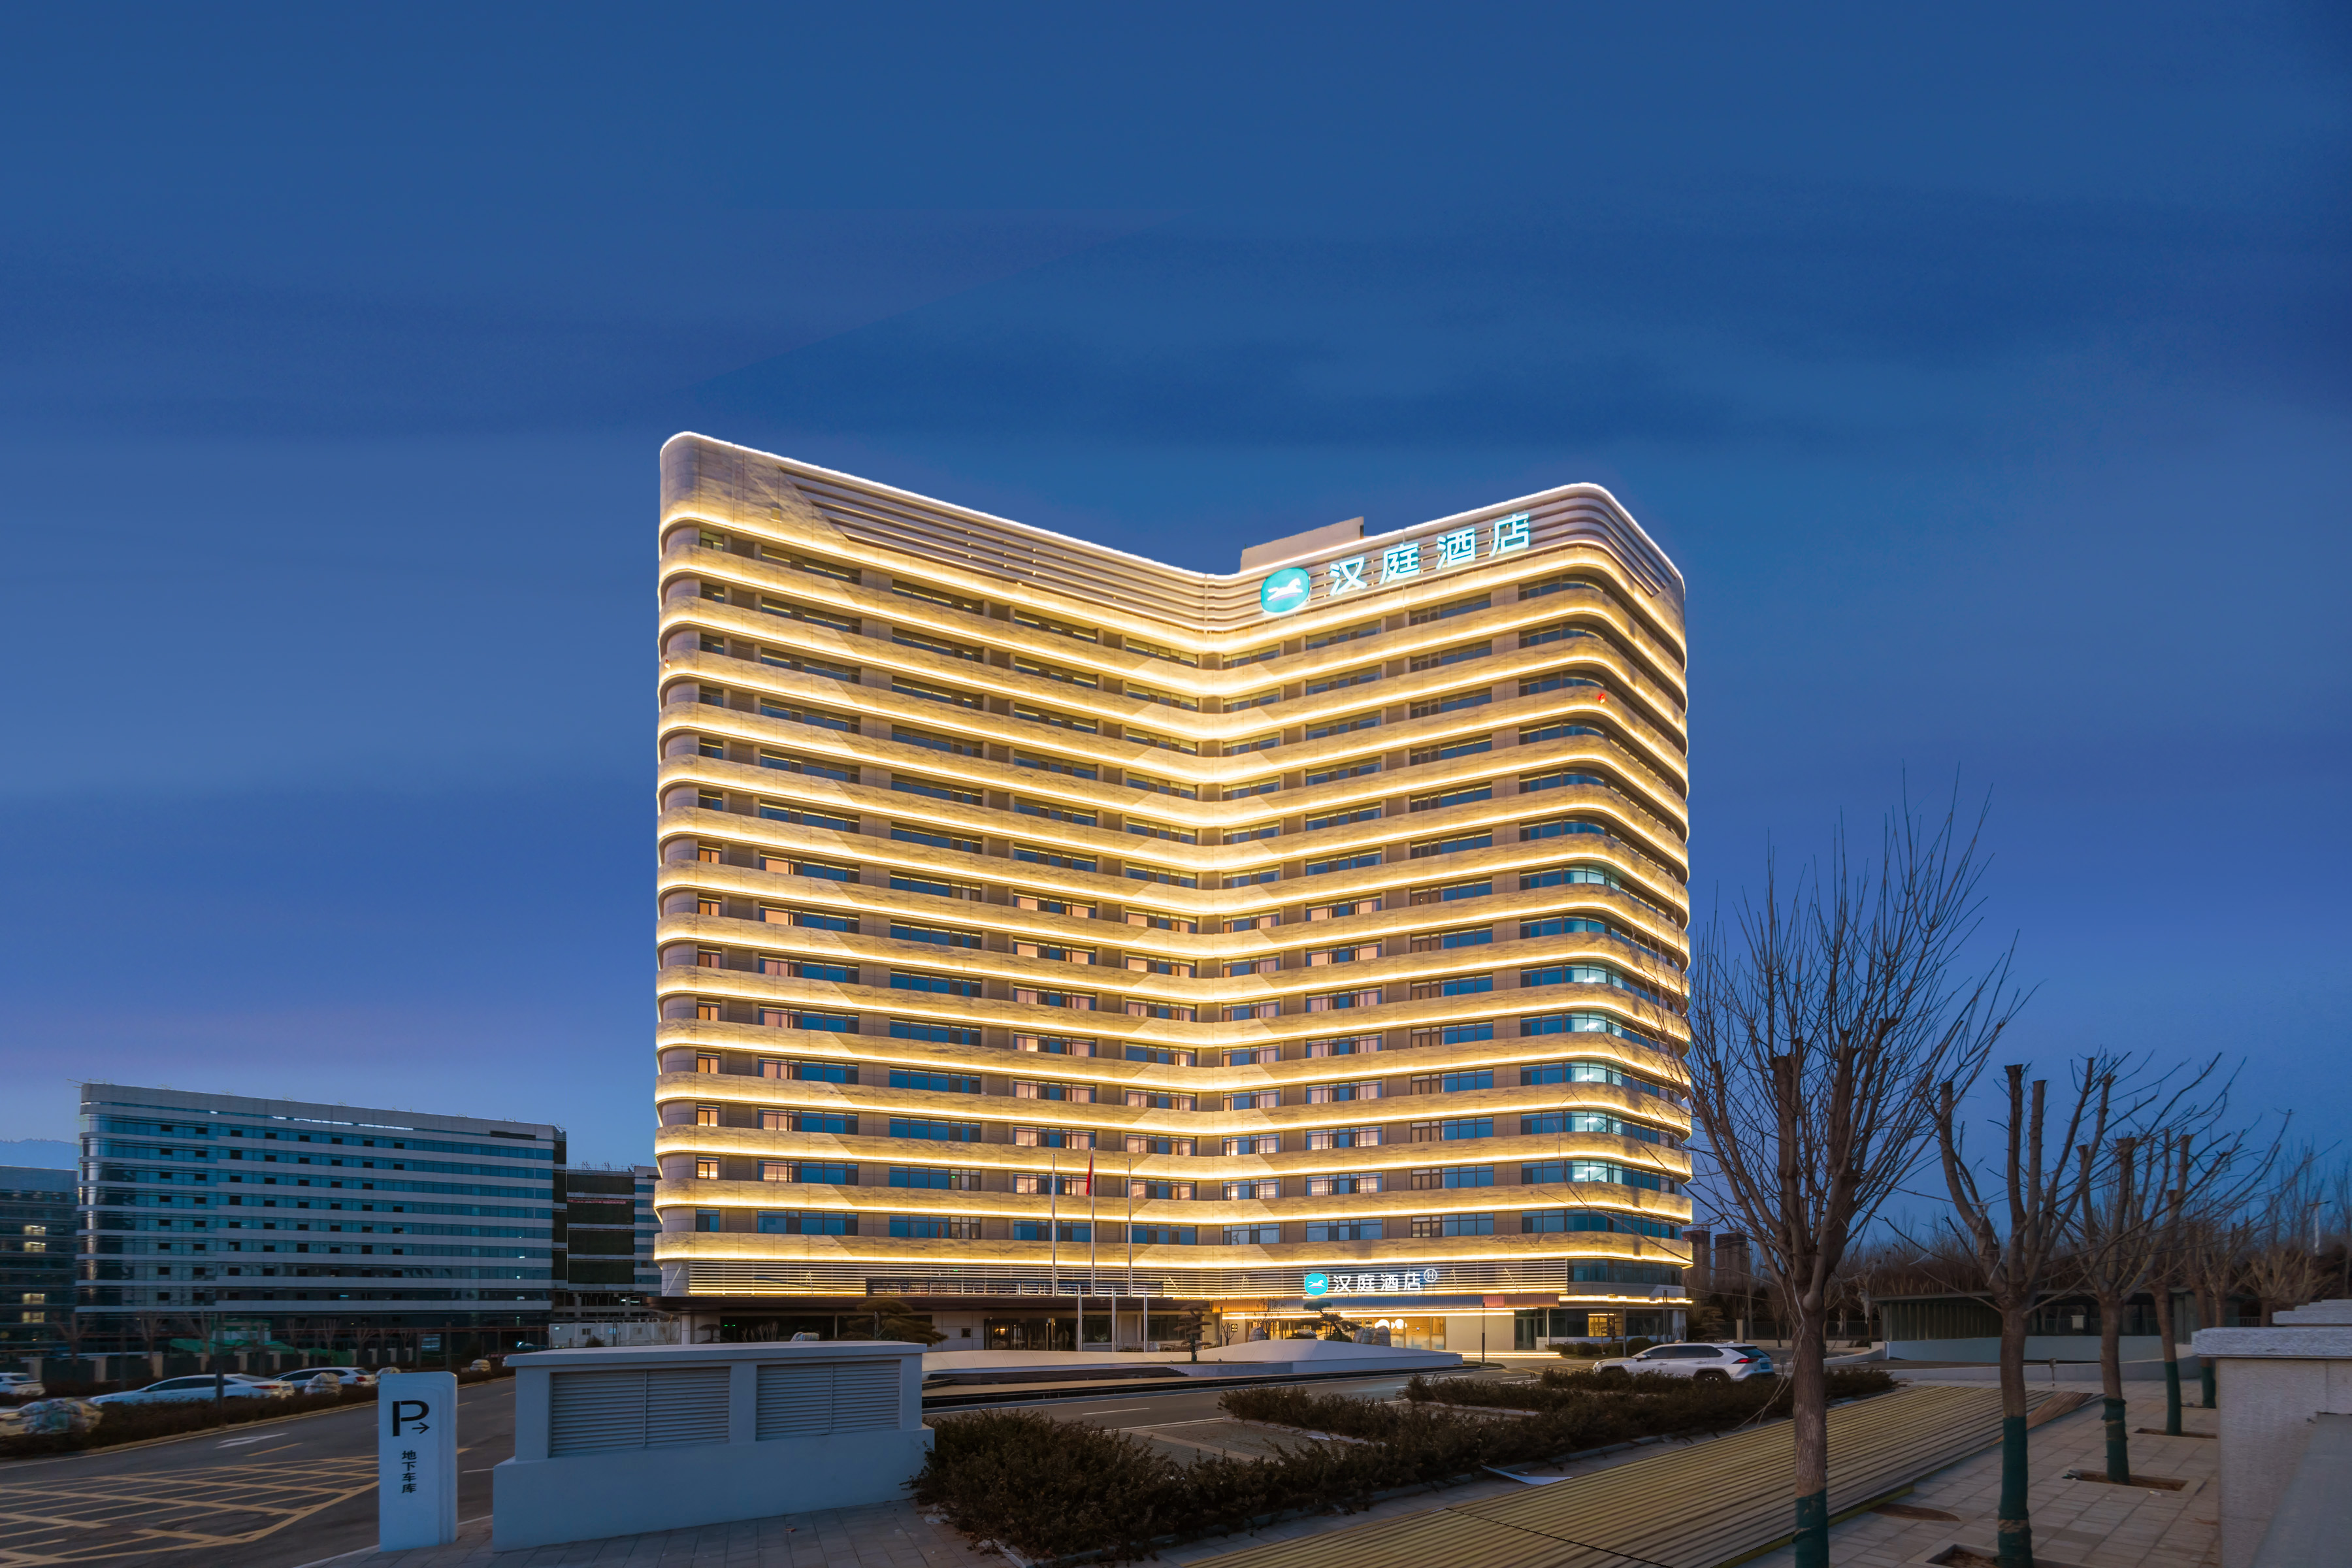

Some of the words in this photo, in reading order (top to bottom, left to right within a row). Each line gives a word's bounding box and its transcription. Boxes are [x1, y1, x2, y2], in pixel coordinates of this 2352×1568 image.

[1329, 513, 1529, 596] 汉庭酒店
[1333, 1273, 1420, 1292] 汉庭酒店
[393, 1400, 429, 1437] P
[402, 1450, 417, 1494] 地下车库
